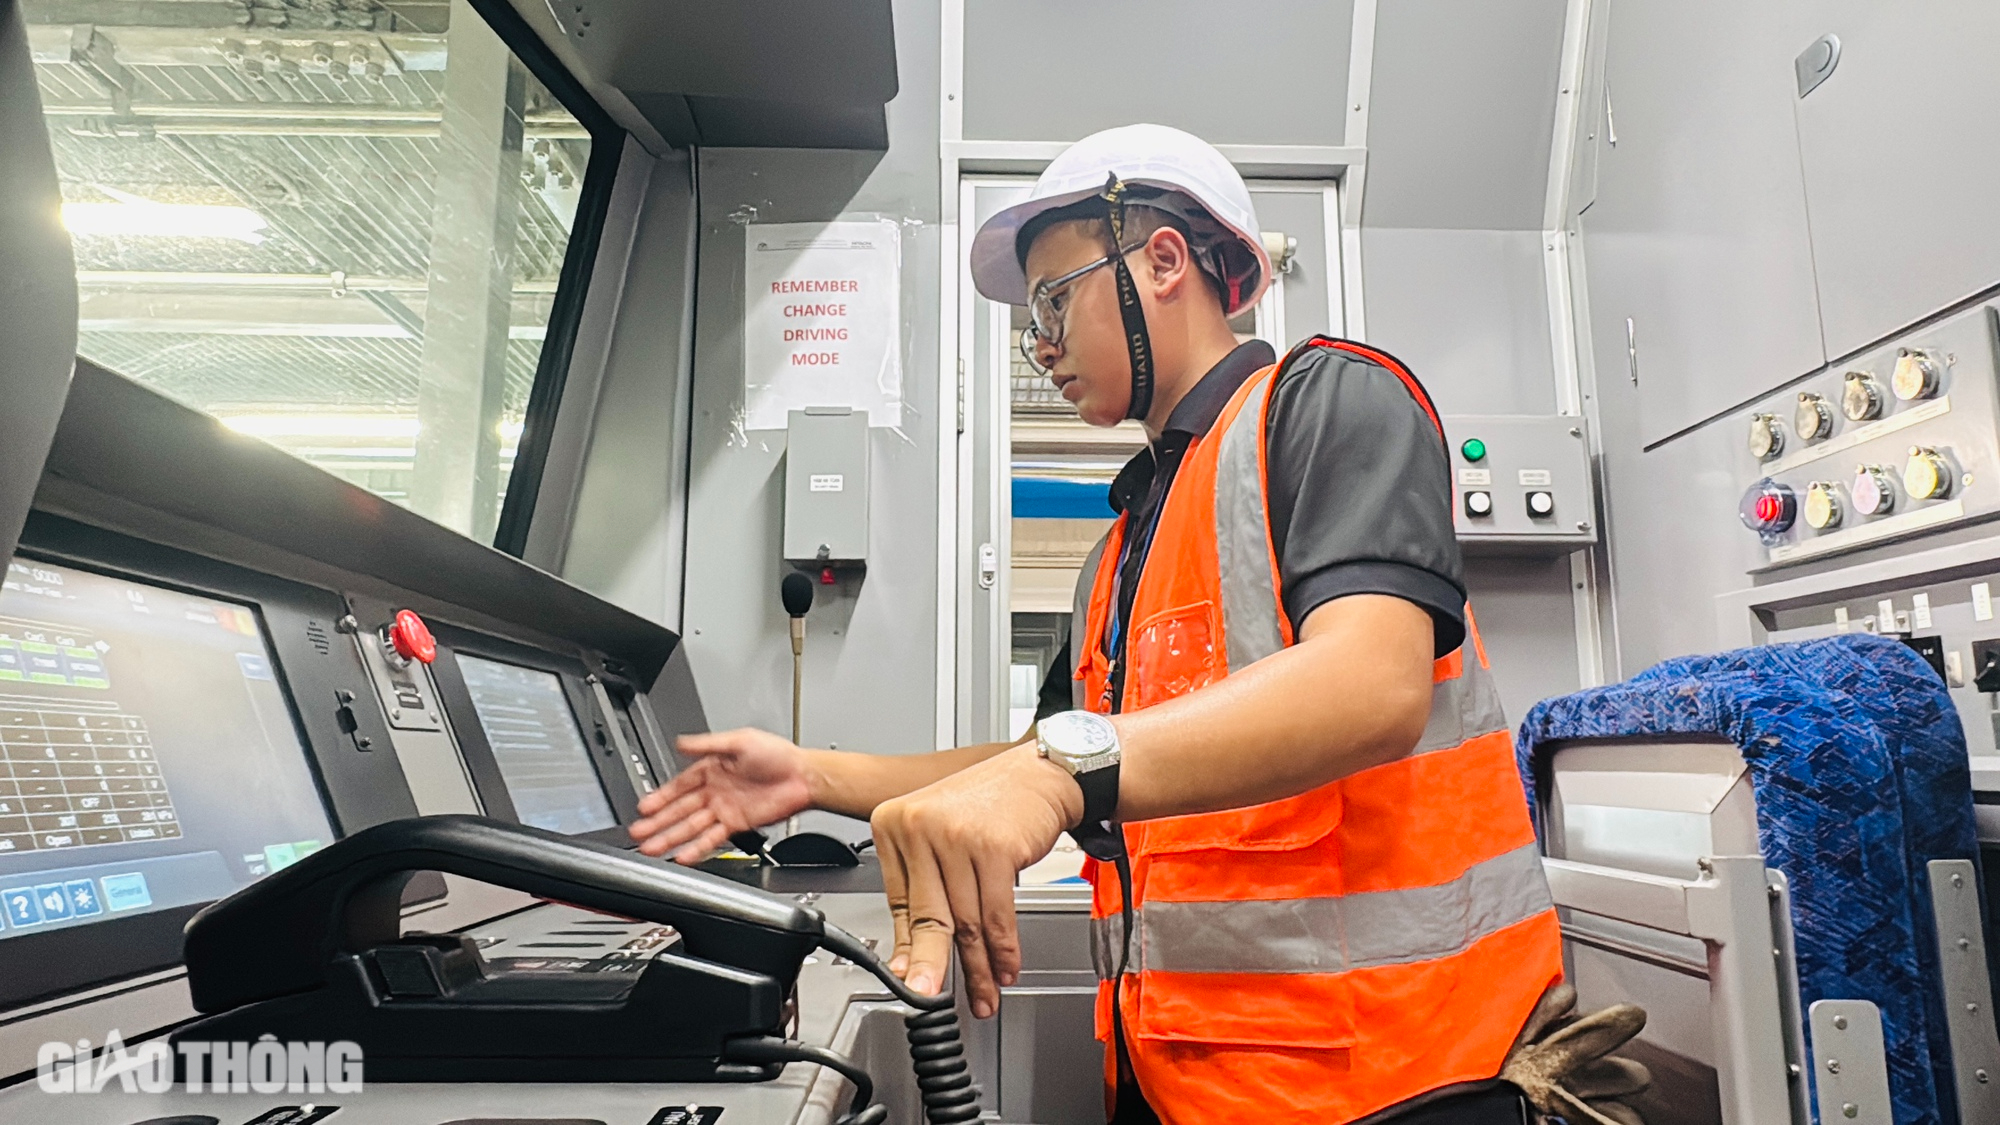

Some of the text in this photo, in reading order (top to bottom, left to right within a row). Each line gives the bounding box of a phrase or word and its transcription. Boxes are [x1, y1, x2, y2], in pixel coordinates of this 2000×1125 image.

[771, 280, 858, 294] REMEMBER
[783, 304, 847, 317] CHANGE
[783, 328, 848, 341] DRIVING
[792, 352, 840, 365] MODE
